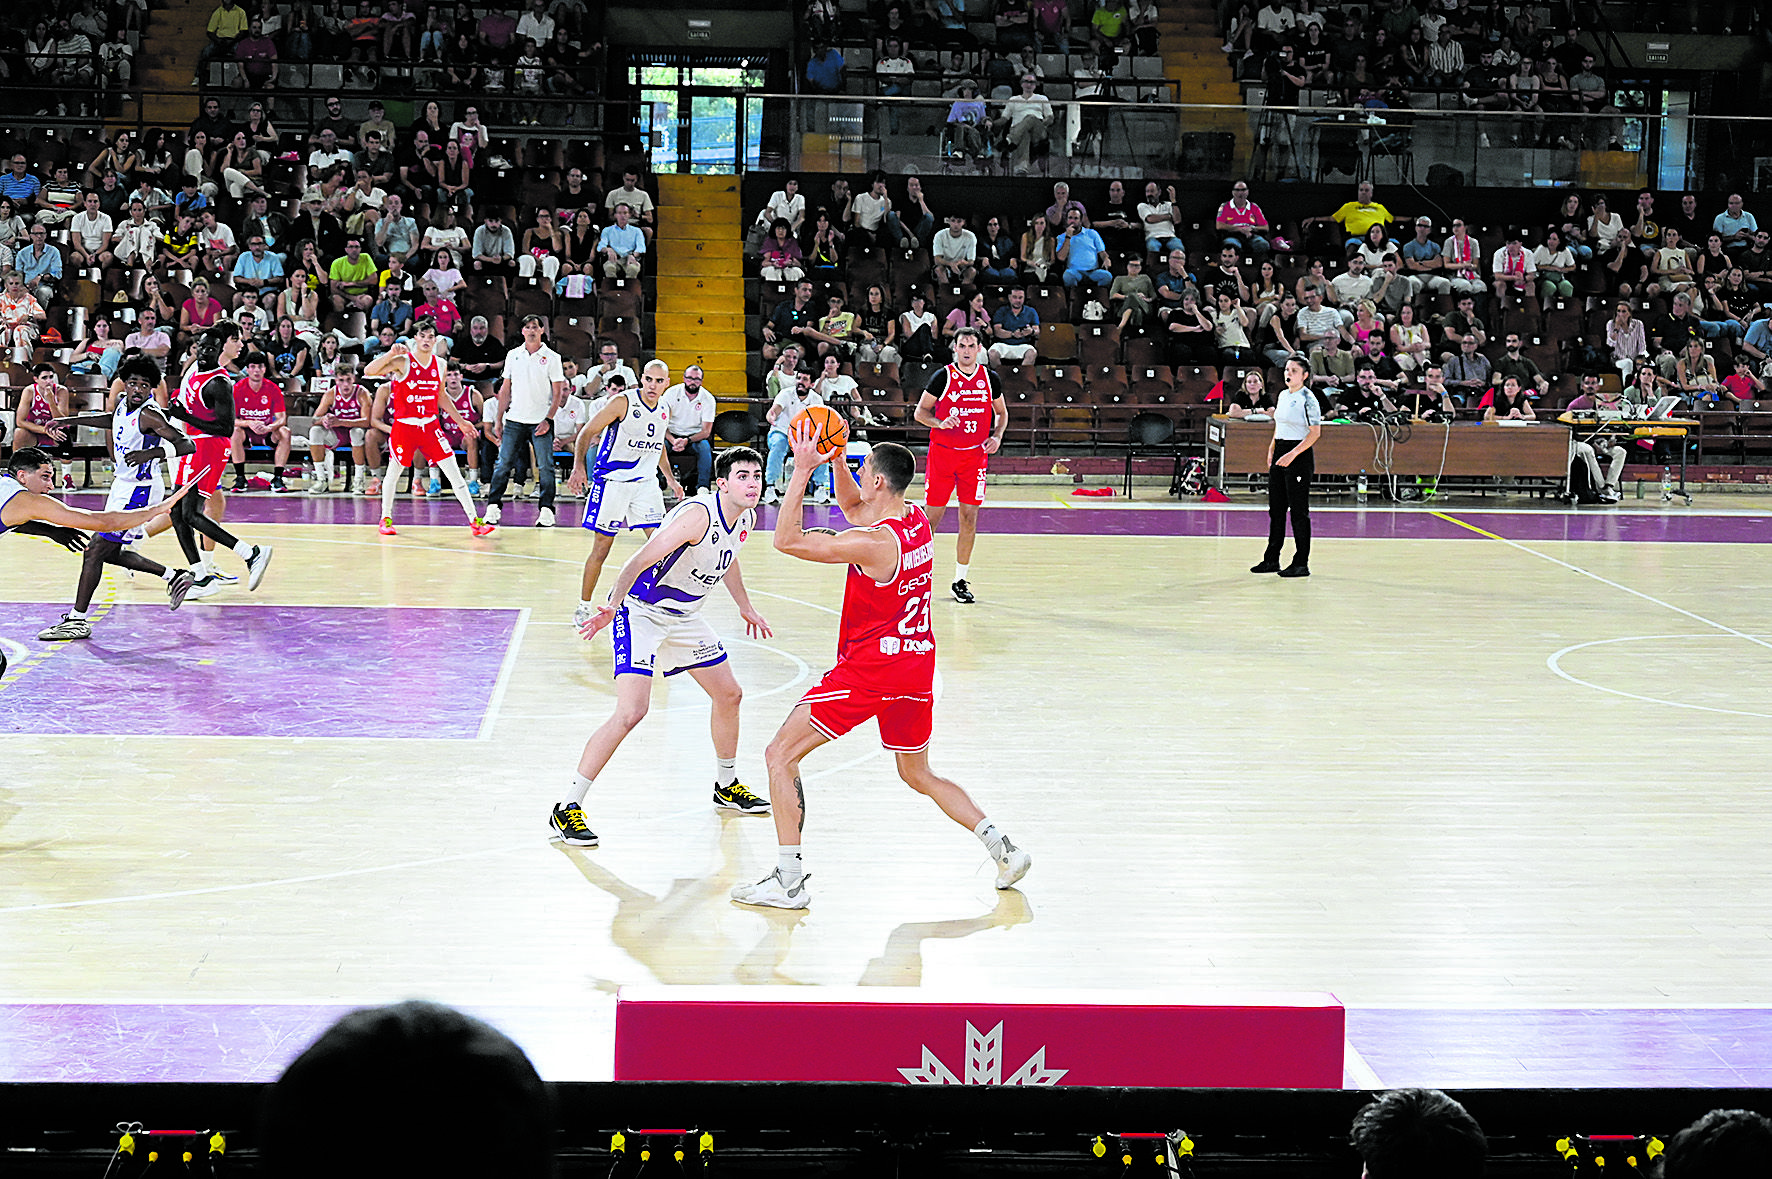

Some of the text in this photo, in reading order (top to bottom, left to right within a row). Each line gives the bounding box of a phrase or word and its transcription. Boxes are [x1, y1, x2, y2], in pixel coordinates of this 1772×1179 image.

[116, 426, 124, 440] 2
[646, 423, 656, 437] 9
[963, 420, 978, 433] 33
[628, 439, 662, 450] UEMC
[715, 549, 733, 571] 10
[897, 591, 932, 636] 23
